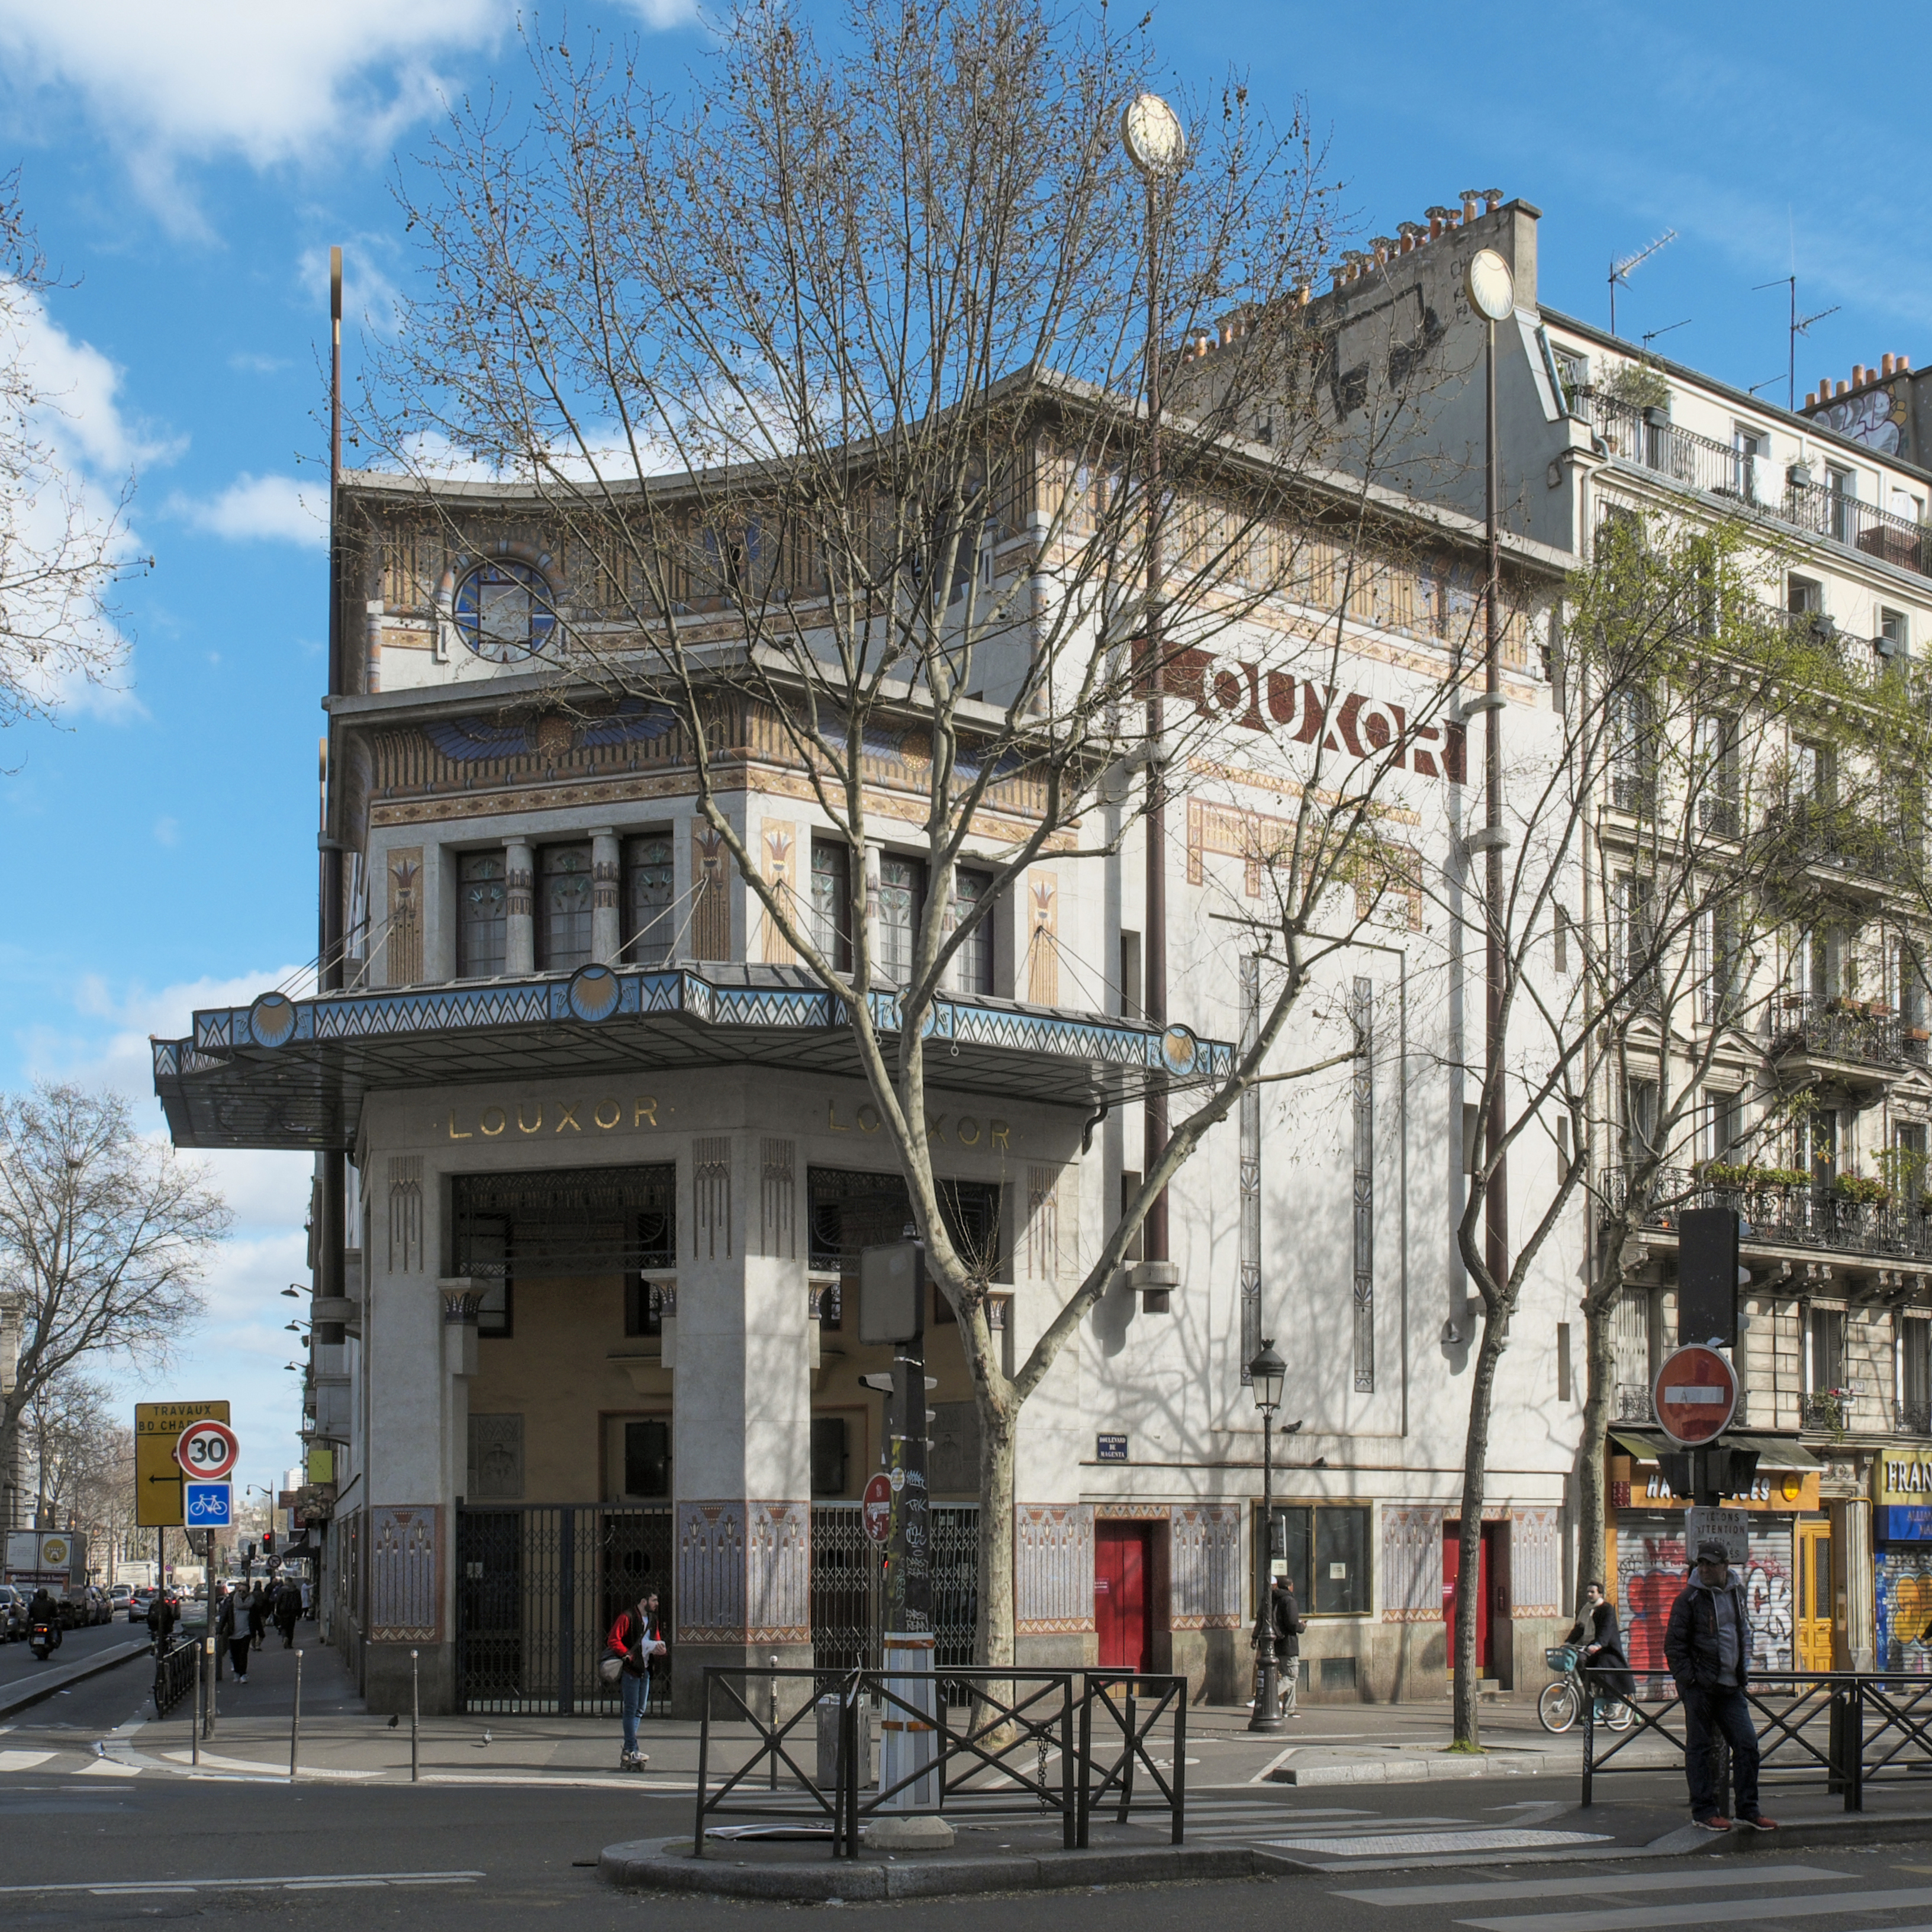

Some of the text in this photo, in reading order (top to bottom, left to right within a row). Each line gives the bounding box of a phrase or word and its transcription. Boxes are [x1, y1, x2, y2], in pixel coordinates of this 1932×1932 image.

[450, 1096, 658, 1139] LOUXOR
[829, 1099, 1010, 1149] LOXOR
[153, 1405, 211, 1416] TRAVAUX
[139, 1421, 154, 1431] BD
[191, 1437, 226, 1463] 30
[1886, 1461, 1932, 1492] FRAN
[1698, 1511, 1740, 1522] IÉONS
